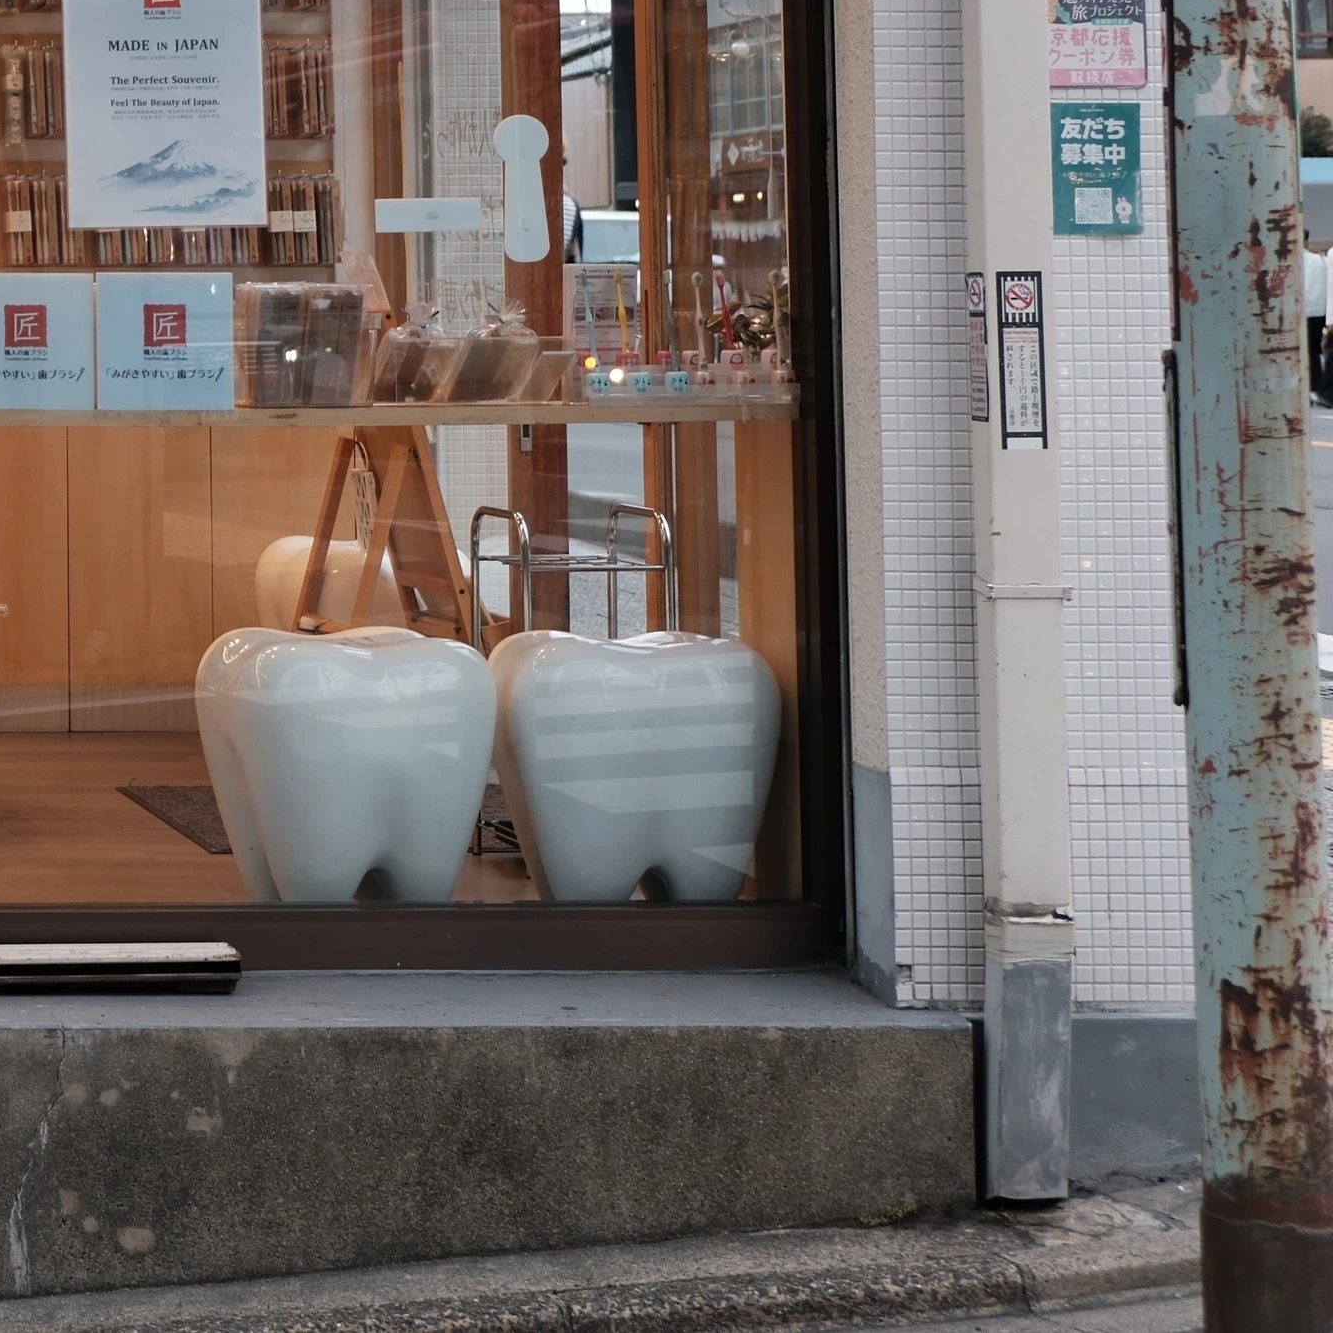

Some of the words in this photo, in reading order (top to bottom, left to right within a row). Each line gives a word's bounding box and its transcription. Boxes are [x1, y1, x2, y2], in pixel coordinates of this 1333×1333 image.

[1071, 3, 1144, 21] 旅プロジェクト
[108, 39, 150, 52] MADE
[156, 42, 168, 51] IN
[174, 38, 219, 53] JAPAN
[1050, 27, 1131, 47] 京都応援
[1049, 47, 1136, 66] クーポン券
[110, 76, 129, 85] The
[132, 75, 168, 85] Perfect
[171, 74, 220, 84] Souvenir.
[1070, 70, 1115, 84] 取扱店
[110, 99, 129, 107] Feel
[150, 98, 180, 108] Beauty
[182, 97, 191, 106] of
[193, 97, 220, 107] Japan.
[1060, 116, 1126, 140] 友だち
[1060, 143, 1126, 165] 募集中
[13, 312, 41, 342] 匠
[153, 312, 180, 342] 匠
[105, 368, 215, 380] 「みがきやすい」歯ブラシ
